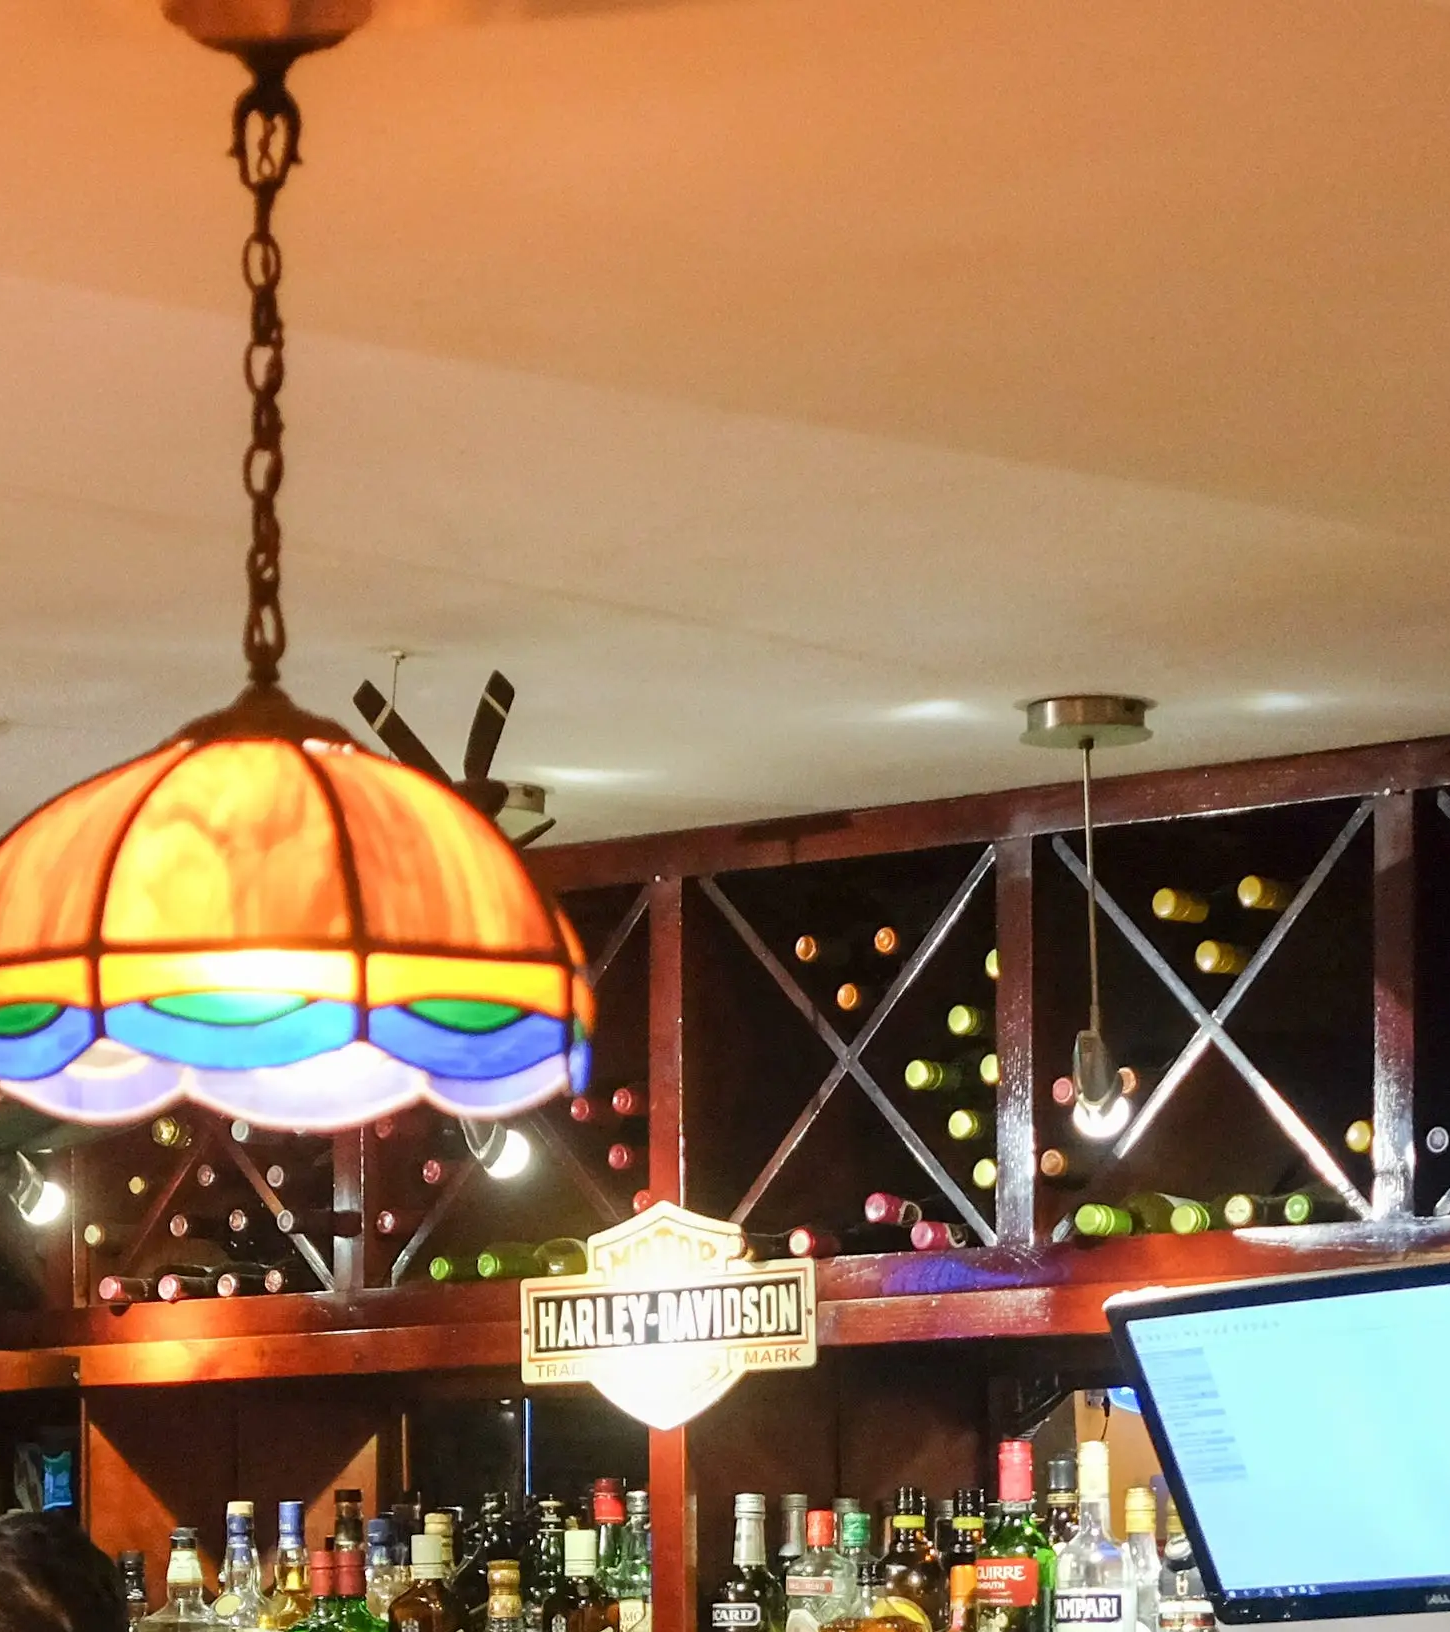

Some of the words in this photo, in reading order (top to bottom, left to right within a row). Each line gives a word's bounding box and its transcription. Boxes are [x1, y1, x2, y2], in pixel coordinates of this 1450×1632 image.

[537, 1282, 800, 1351] HARLEY-DAVIDSON
[743, 1346, 803, 1365] MARK
[977, 1564, 1026, 1581] GUIRRE
[978, 1581, 1006, 1590] MOUTH
[713, 1608, 753, 1622] CARD
[1056, 1597, 1119, 1620] AMPARI
